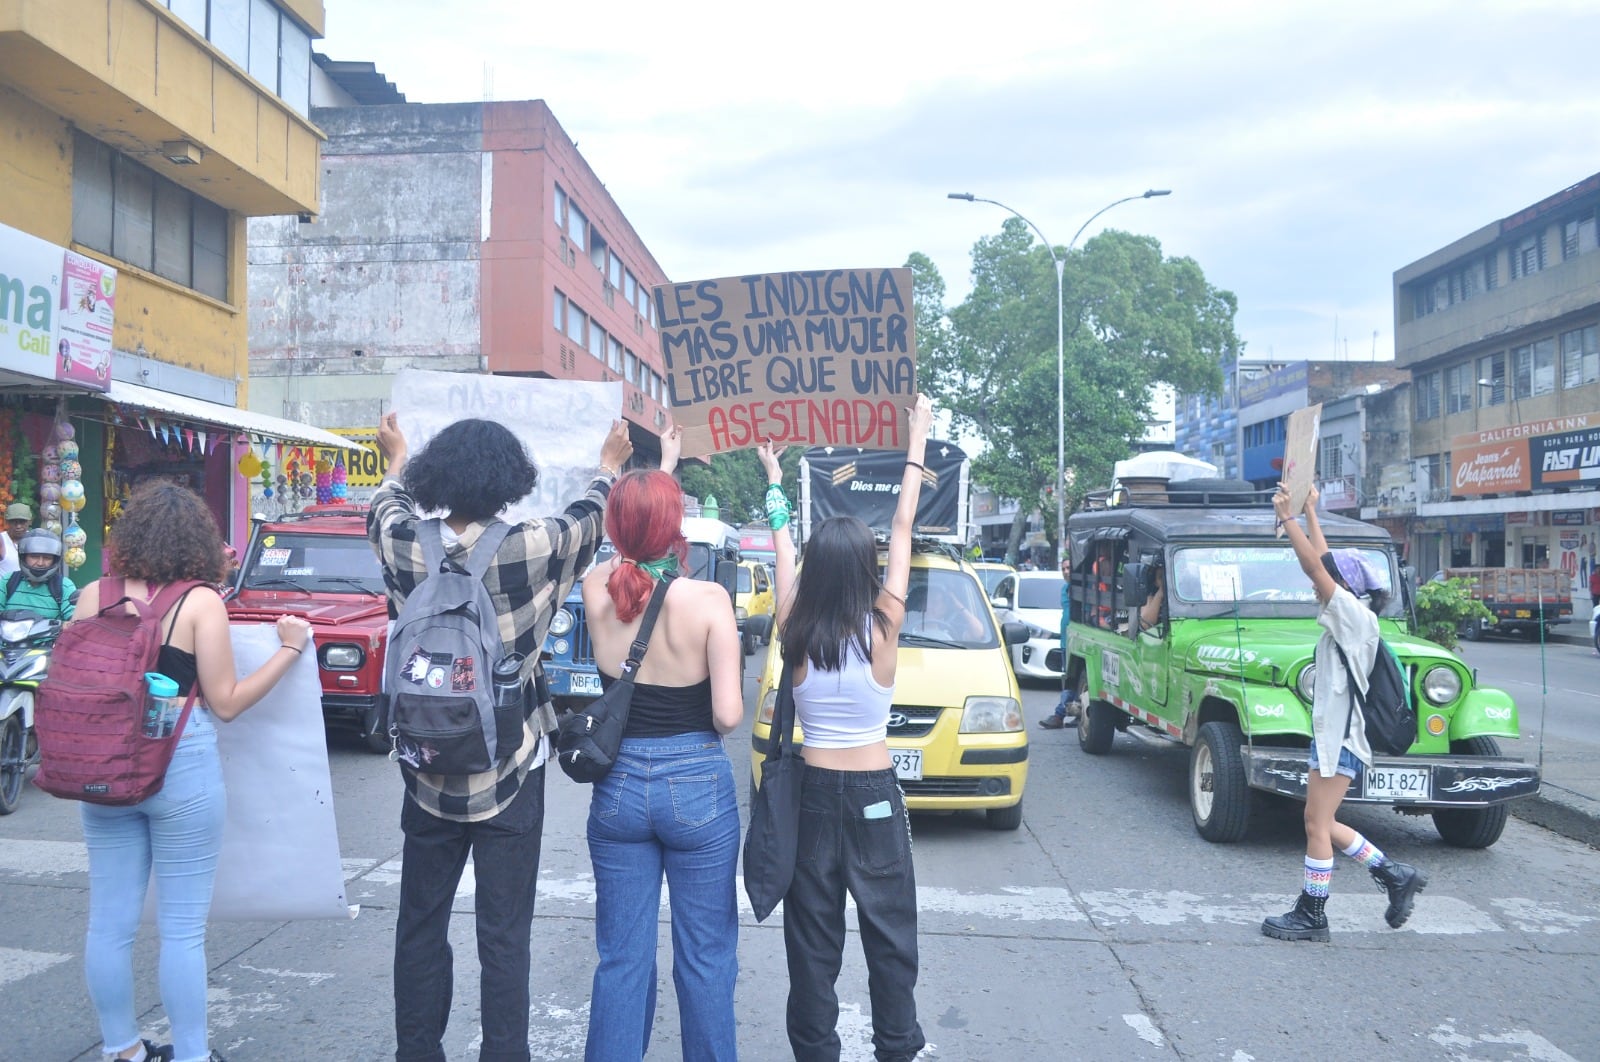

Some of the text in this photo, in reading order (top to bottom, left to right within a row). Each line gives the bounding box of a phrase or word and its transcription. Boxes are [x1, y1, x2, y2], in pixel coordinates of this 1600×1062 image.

[653, 269, 904, 328] LES INDIGNA
[18, 329, 51, 356] Cali
[661, 313, 908, 369] MAS UNA MUJER
[667, 355, 914, 407] LIBRE QUE UNA
[708, 398, 899, 451] ASESINADA
[1480, 421, 1555, 443] CALIFORNIA
[1565, 434, 1584, 444] PARA
[1475, 453, 1500, 465] Jeans
[1542, 447, 1580, 471] FAST
[1456, 457, 1522, 488] Chaparral
[850, 480, 873, 491] Dios
[874, 483, 892, 491] me
[572, 676, 591, 687] NBF
[892, 754, 920, 771] 937
[1368, 772, 1427, 791] MBI 827
